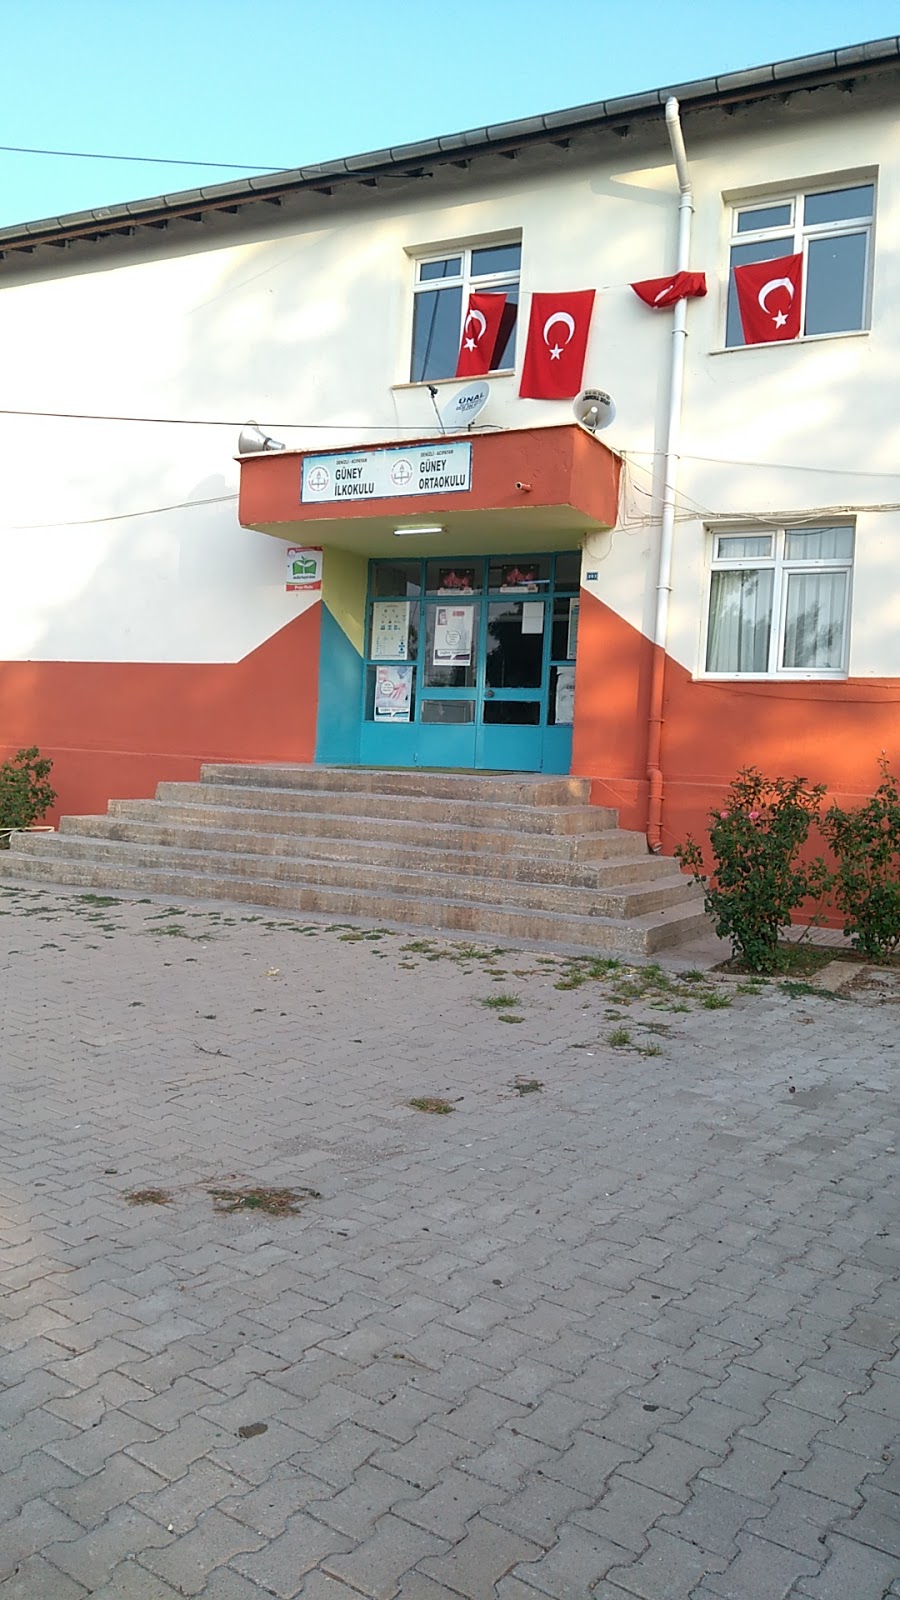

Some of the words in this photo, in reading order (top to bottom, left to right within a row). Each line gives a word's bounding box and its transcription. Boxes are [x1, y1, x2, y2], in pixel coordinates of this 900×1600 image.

[420, 459, 447, 473] GÜNEY
[335, 467, 363, 480] GÜNEY
[334, 482, 375, 496] İLKOKULU
[419, 474, 466, 490] ORTAOKULU
